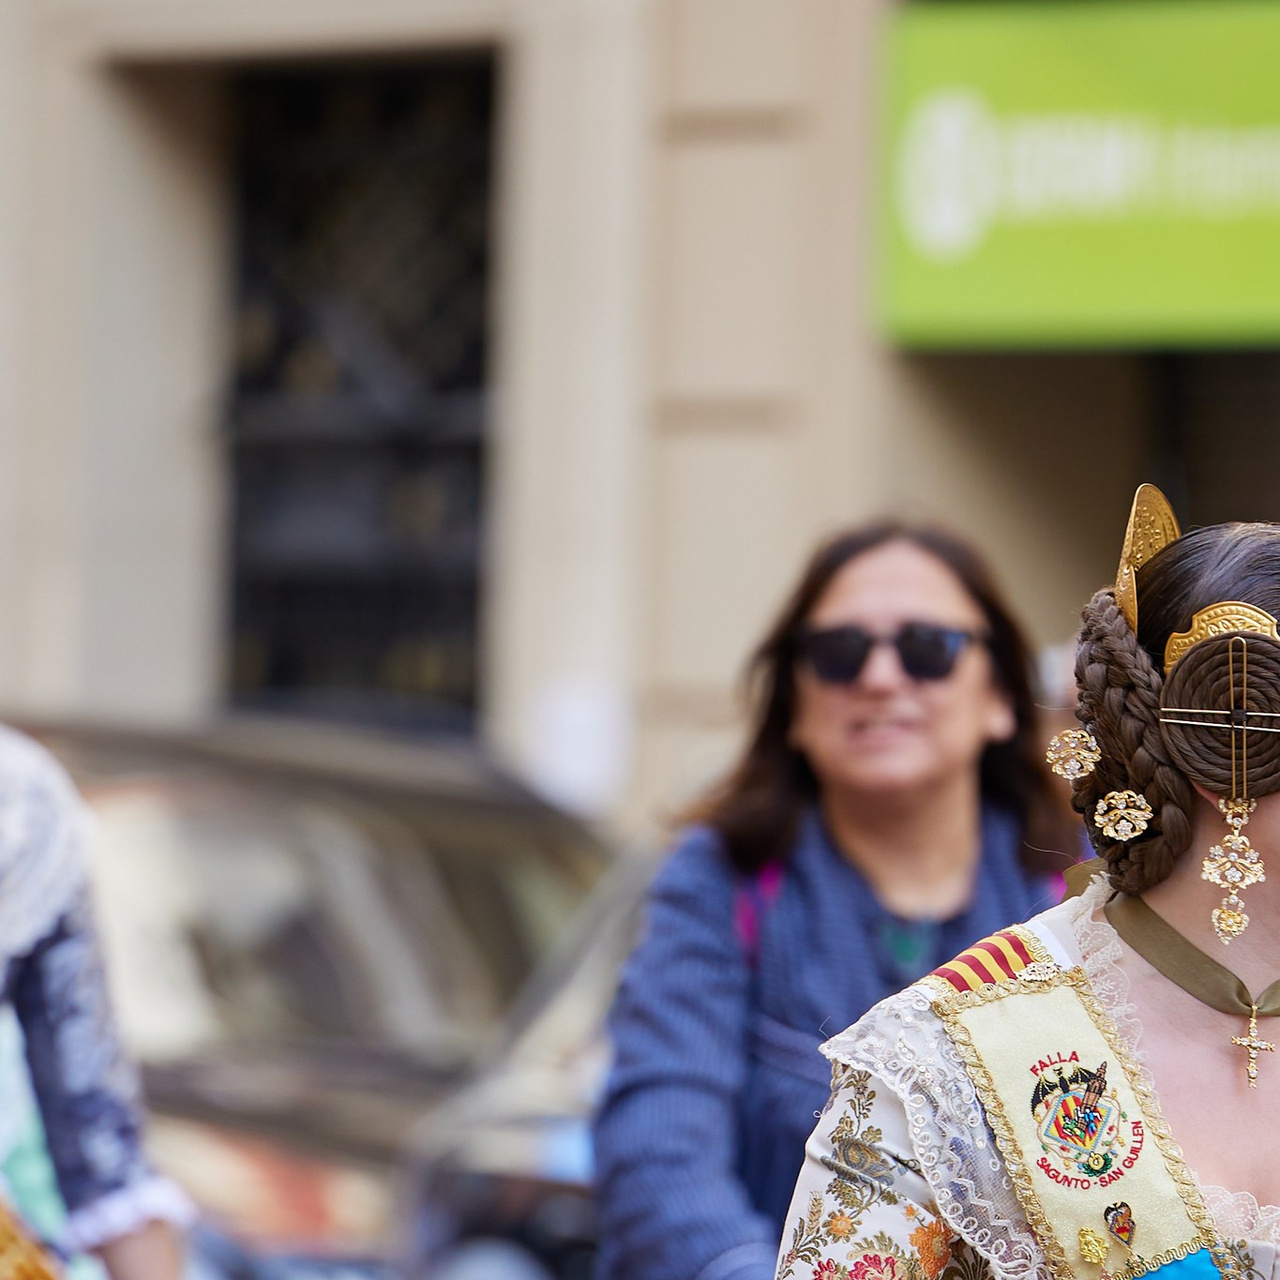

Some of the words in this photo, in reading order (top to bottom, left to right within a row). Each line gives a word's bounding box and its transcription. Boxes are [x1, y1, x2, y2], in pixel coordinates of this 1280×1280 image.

[1030, 1051, 1080, 1077] FALLA
[1036, 1156, 1091, 1190] SAGUNTO
[1099, 1167, 1125, 1188] SAN
[1122, 1120, 1144, 1169] GUILLEN
